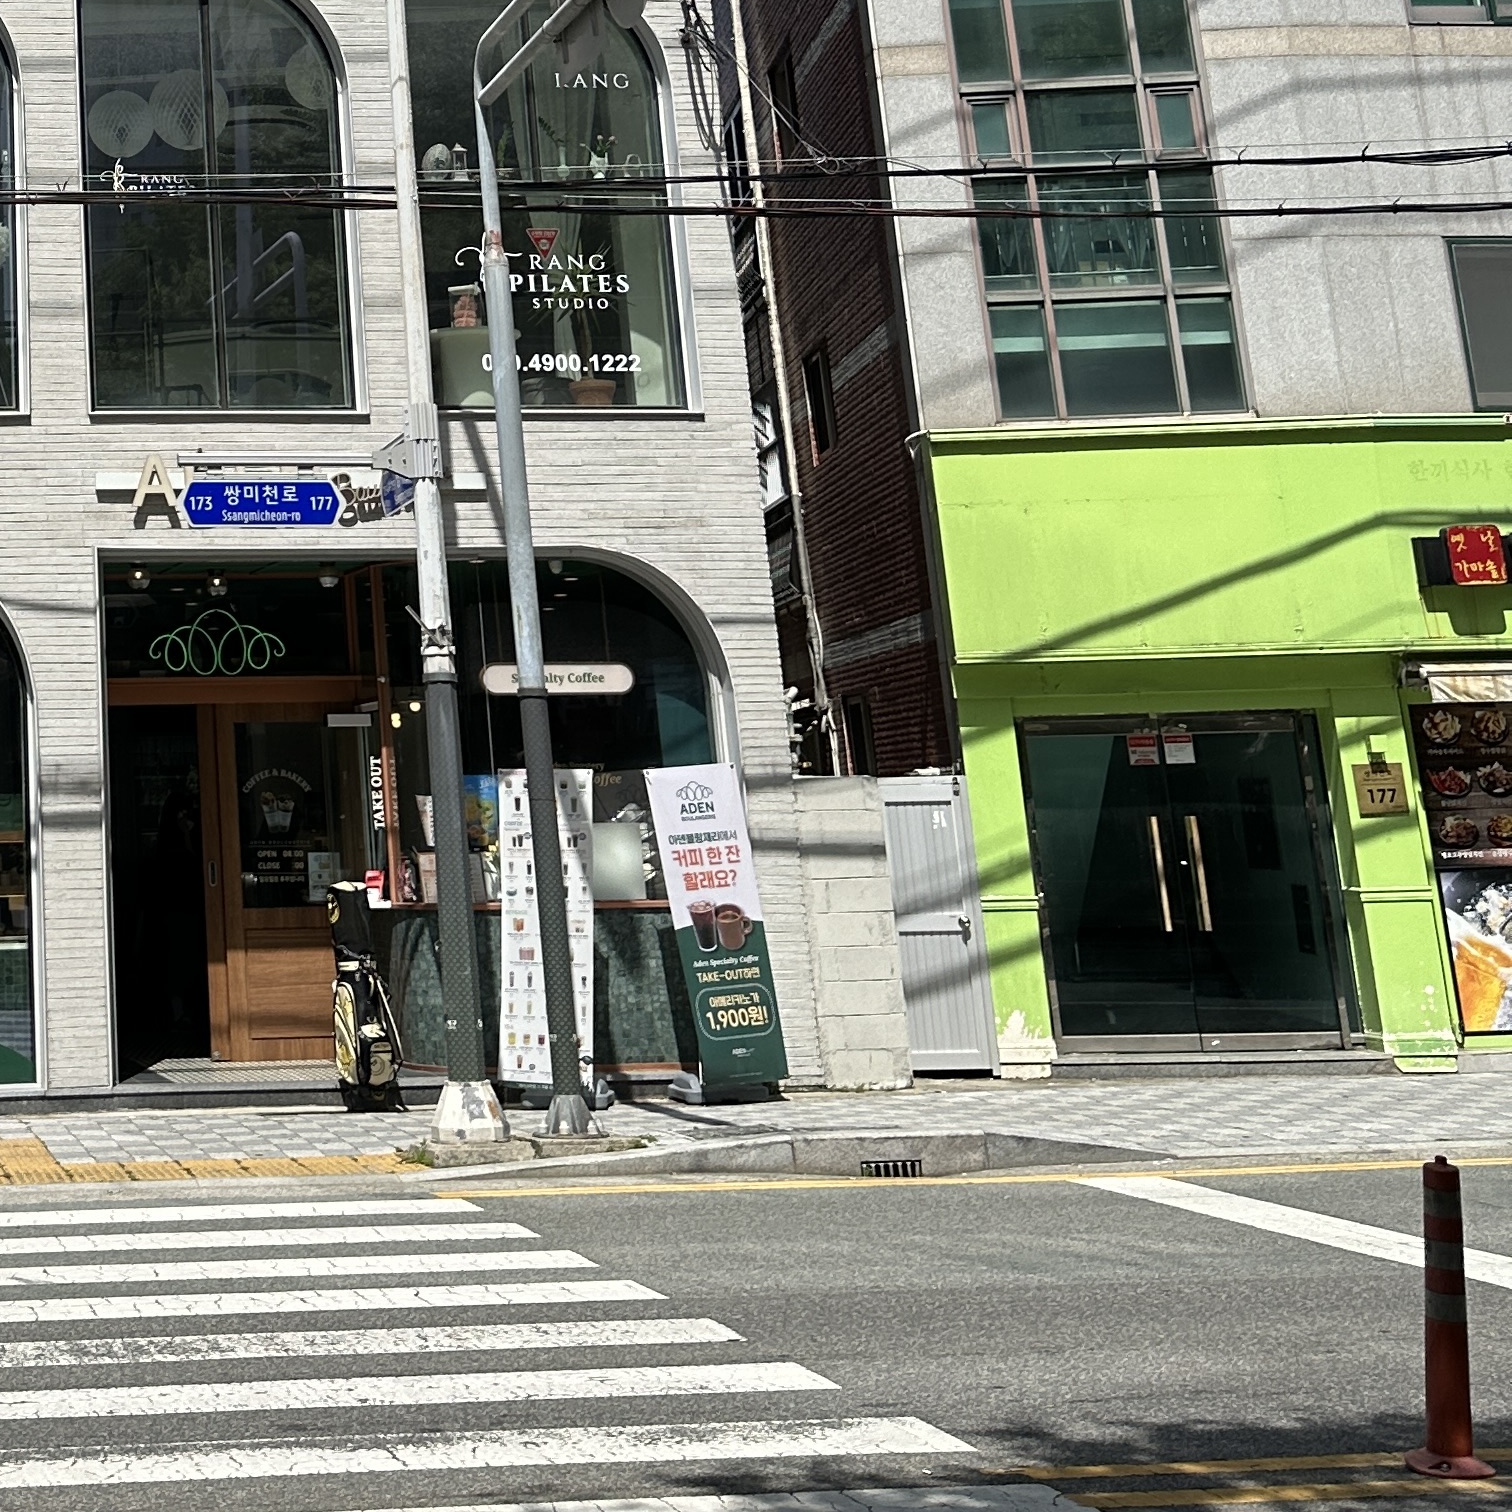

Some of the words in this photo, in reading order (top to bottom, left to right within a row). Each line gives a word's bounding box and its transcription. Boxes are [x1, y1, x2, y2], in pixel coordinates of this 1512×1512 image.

[529, 254, 606, 271] RANG
[508, 274, 630, 294] PILATES
[532, 296, 610, 310] STUDIO
[481, 353, 642, 373] 0.4900.1222
[189, 496, 213, 512] 173
[223, 485, 300, 506] 쌍미천로
[309, 496, 333, 512] 177
[222, 509, 301, 524] Ssangmicheon-ro
[1454, 558, 1500, 580] 가마솥
[511, 672, 565, 686] Salty
[567, 672, 605, 683] Coffee
[369, 756, 383, 788] OUT
[593, 773, 623, 787] offee
[1367, 788, 1397, 804] 177
[371, 789, 386, 831] TAKE
[680, 801, 716, 816] ADEN
[671, 847, 704, 867] 커피
[705, 845, 723, 866] 한
[725, 844, 741, 864] 잔
[682, 869, 737, 892] 할래요?
[705, 1005, 769, 1031] 1,900원!
